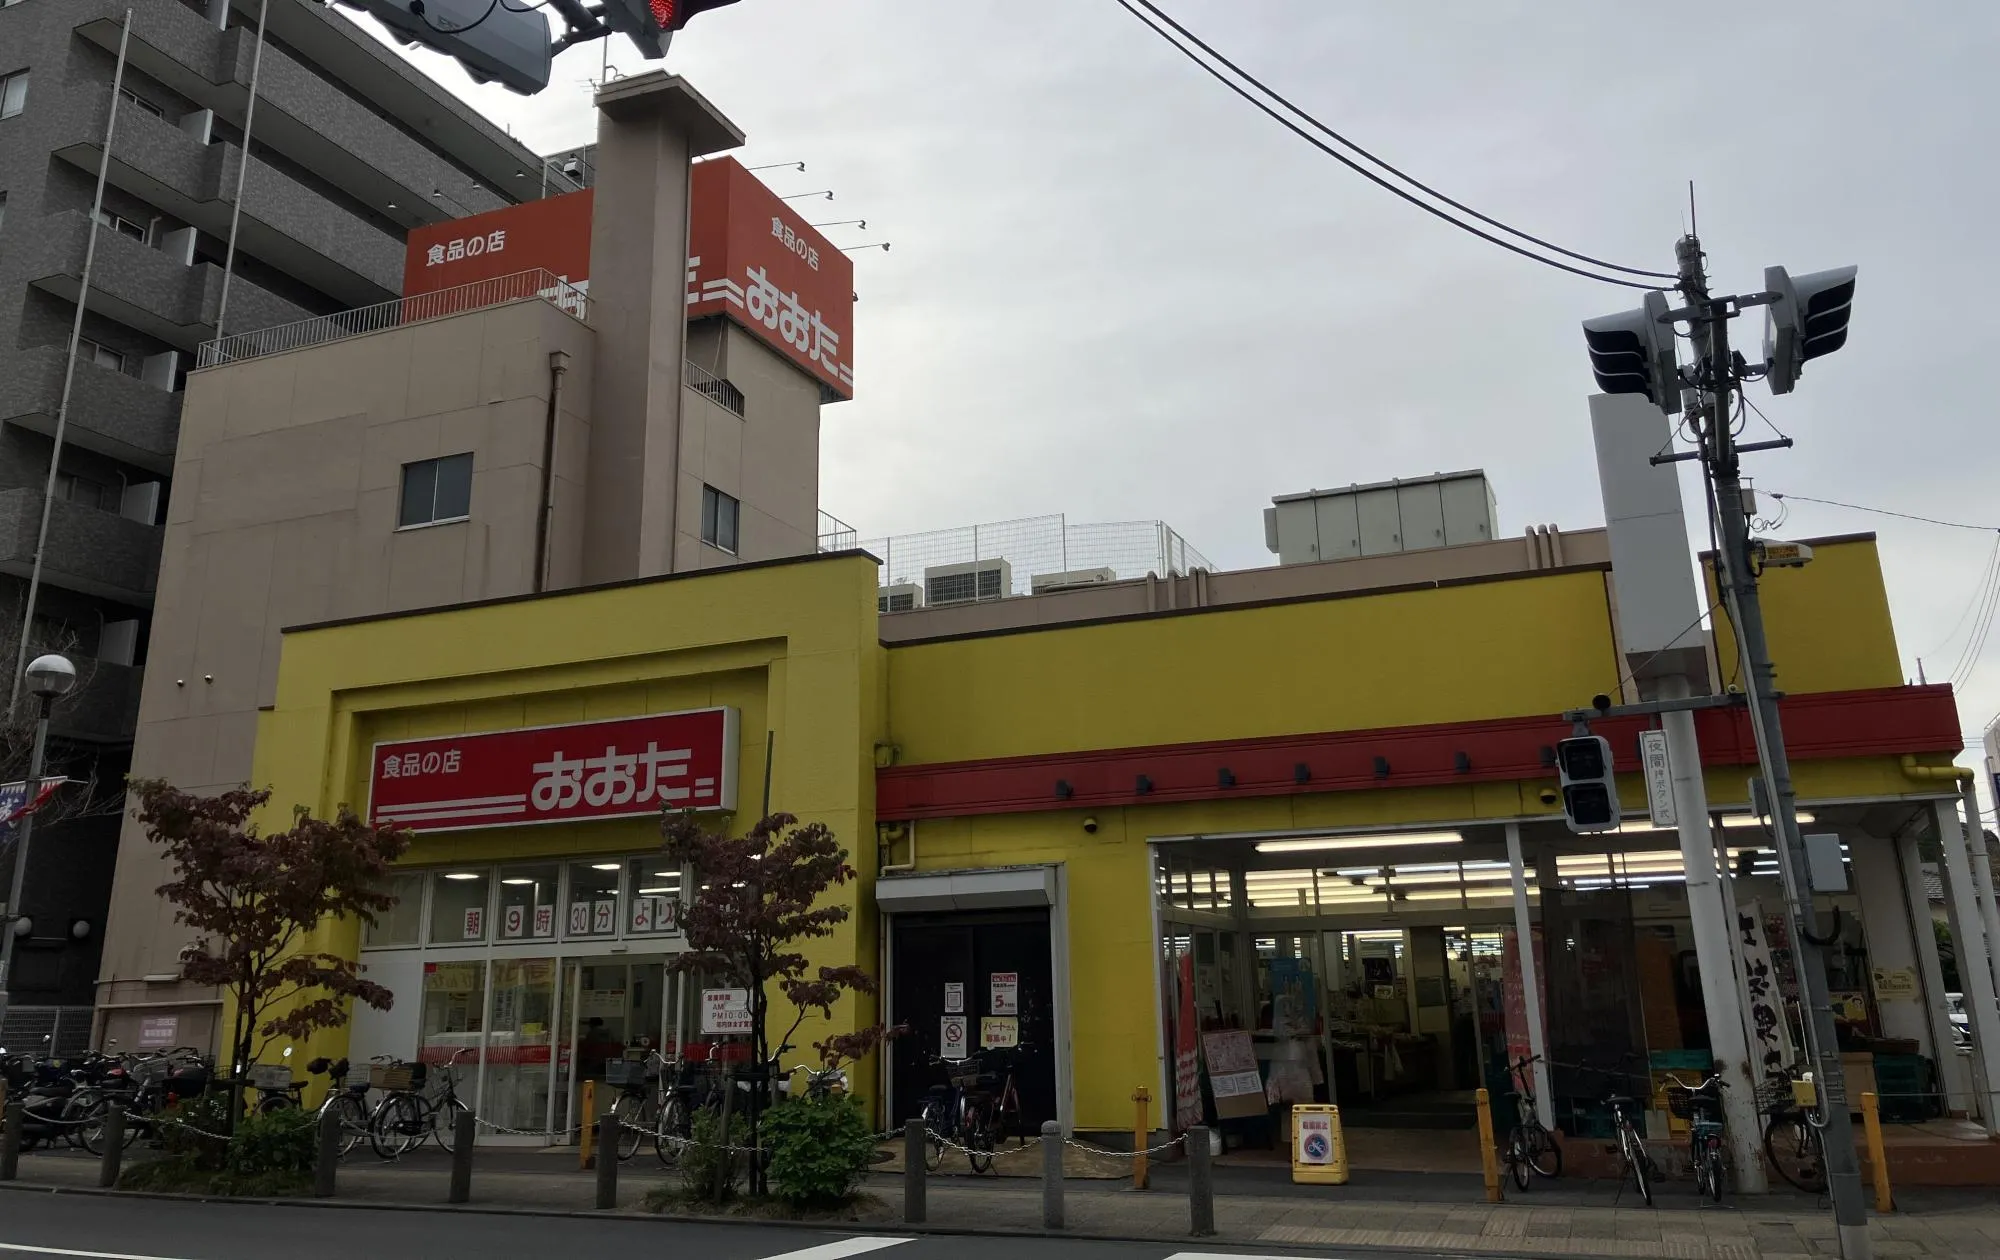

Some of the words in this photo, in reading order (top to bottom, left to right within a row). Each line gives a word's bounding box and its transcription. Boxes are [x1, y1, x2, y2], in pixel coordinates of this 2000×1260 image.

[426, 230, 506, 267] 食品の店
[771, 216, 820, 272] 食品の店
[746, 265, 838, 379] おおた
[382, 749, 462, 779] 食品の店
[531, 741, 692, 811] おおた
[1647, 738, 1670, 818] 夜間押ボタン式
